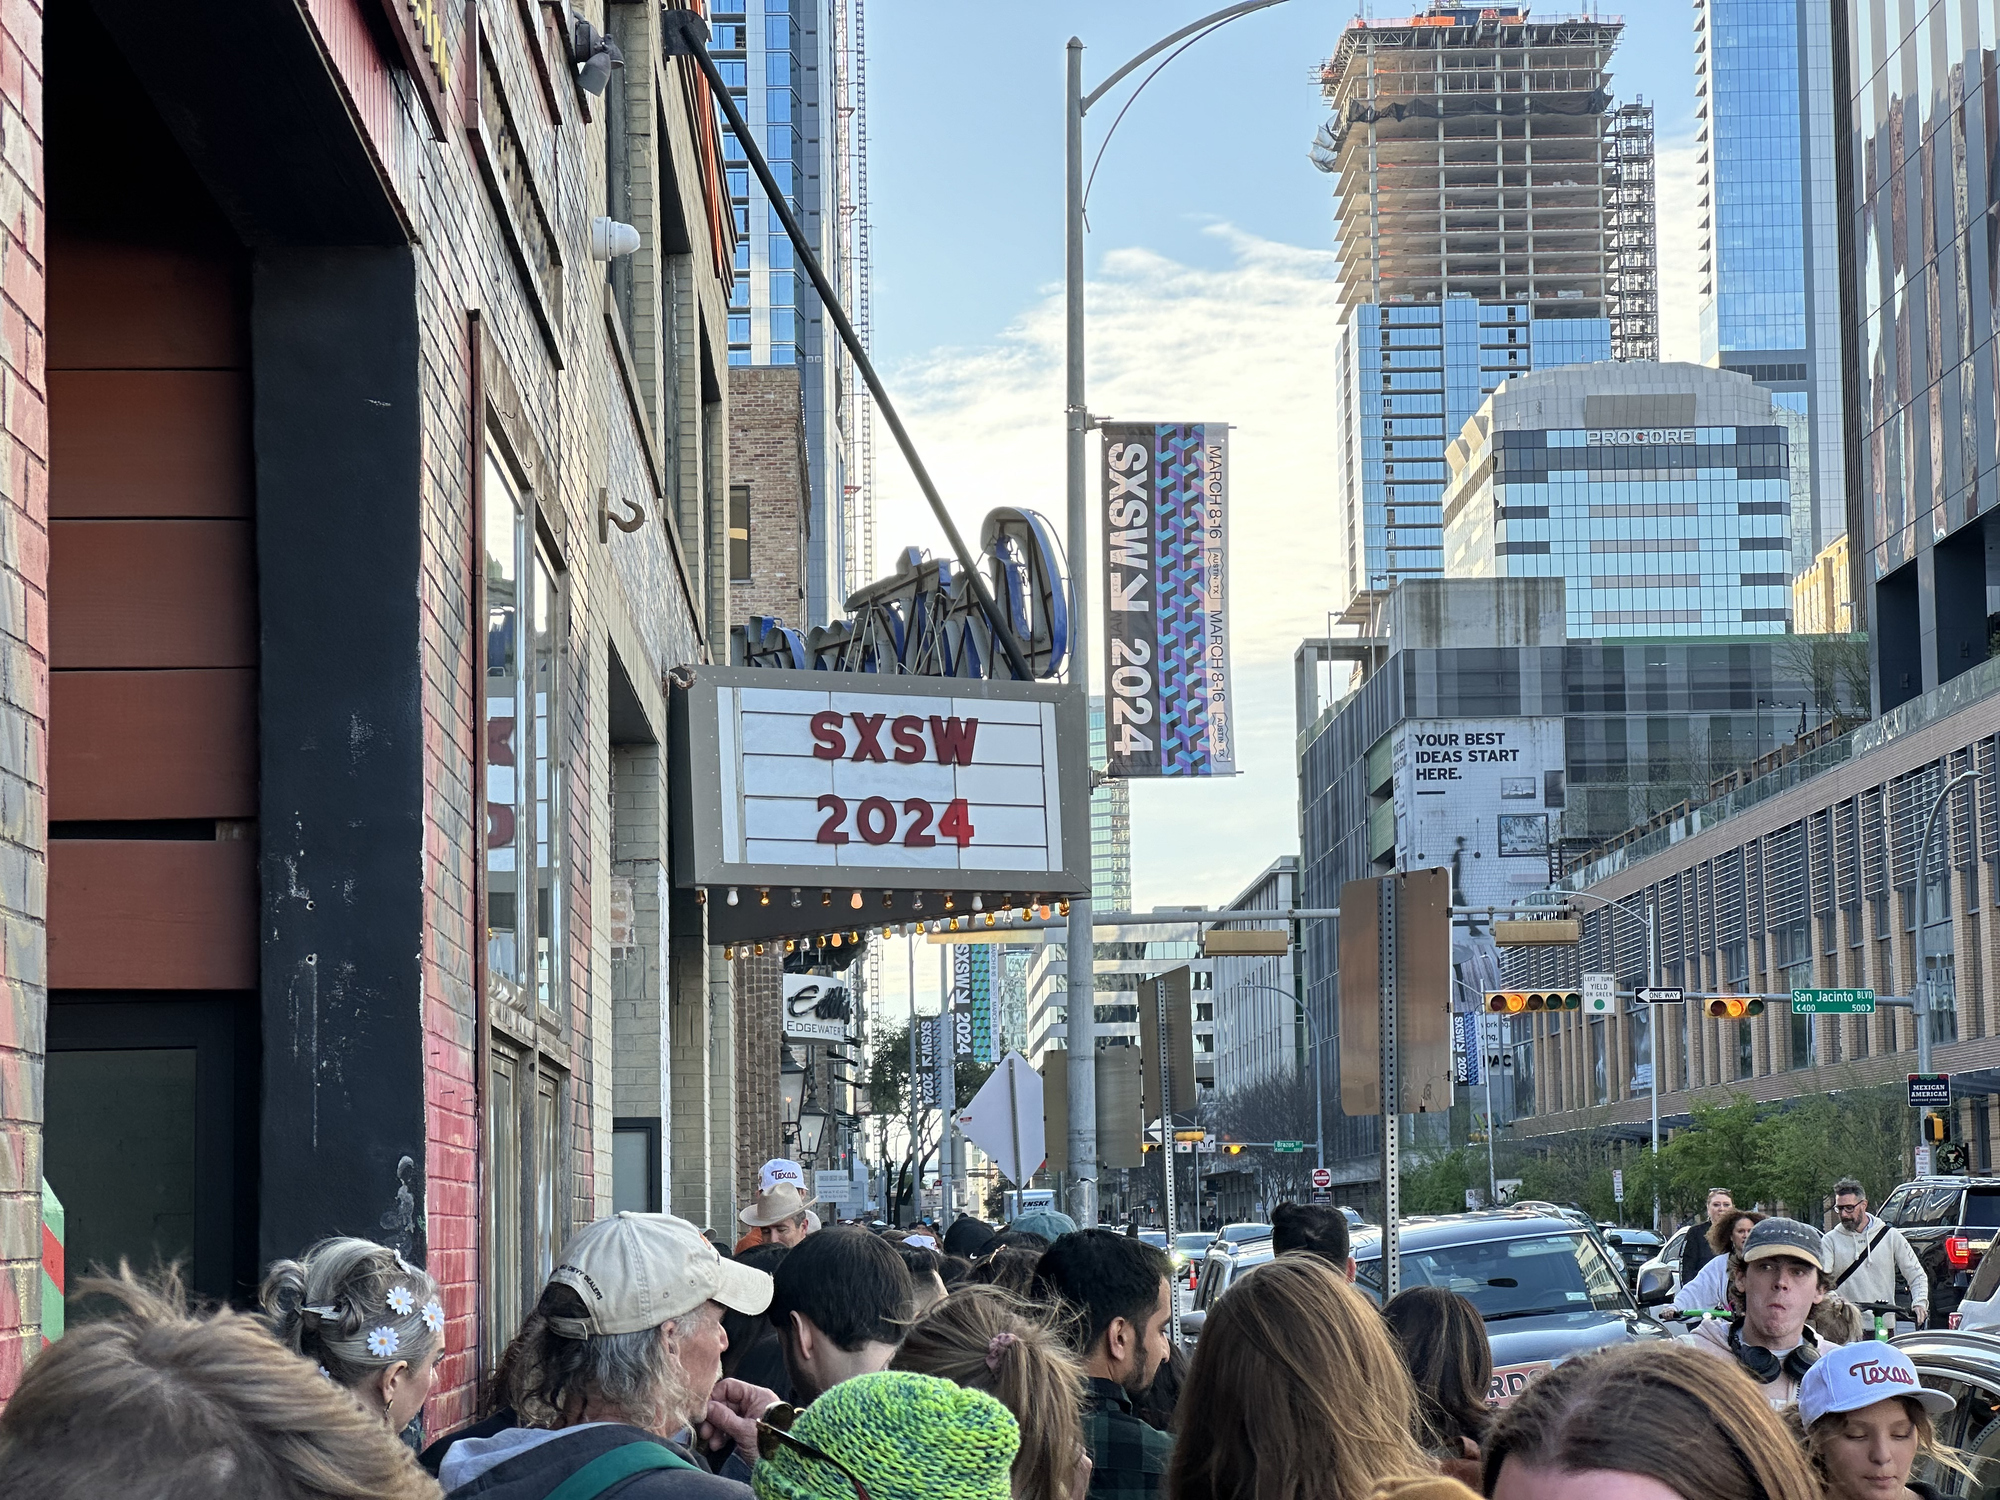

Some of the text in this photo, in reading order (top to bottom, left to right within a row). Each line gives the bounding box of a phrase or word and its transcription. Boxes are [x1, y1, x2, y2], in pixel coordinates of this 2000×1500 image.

[1586, 429, 1696, 445] PROCORE
[1209, 446, 1222, 506] MARCH
[1209, 509, 1223, 539] 8-16
[1108, 443, 1154, 756] SXSW 2024
[1213, 583, 1219, 595] TX
[1210, 611, 1225, 669] MARCH
[1212, 672, 1226, 703] 8-16
[810, 711, 979, 766] SXSW
[1218, 747, 1225, 758] TX
[1415, 732, 1505, 747] YOUR BEST
[1415, 749, 1519, 764] IDEAS START
[1416, 767, 1462, 781] HERE.
[817, 794, 975, 848] 2024
[955, 944, 972, 1055] SXSW 2024
[1794, 991, 1873, 1002] San Jacinto BLVD
[920, 1021, 934, 1104] SXSW 2024
[1454, 1016, 1468, 1082] SXSW 2024
[771, 1169, 798, 1181] Texas
[1018, 1200, 1050, 1208] ENSKE
[583, 1275, 603, 1300] DEALERS
[1849, 1358, 1915, 1386] Texas
